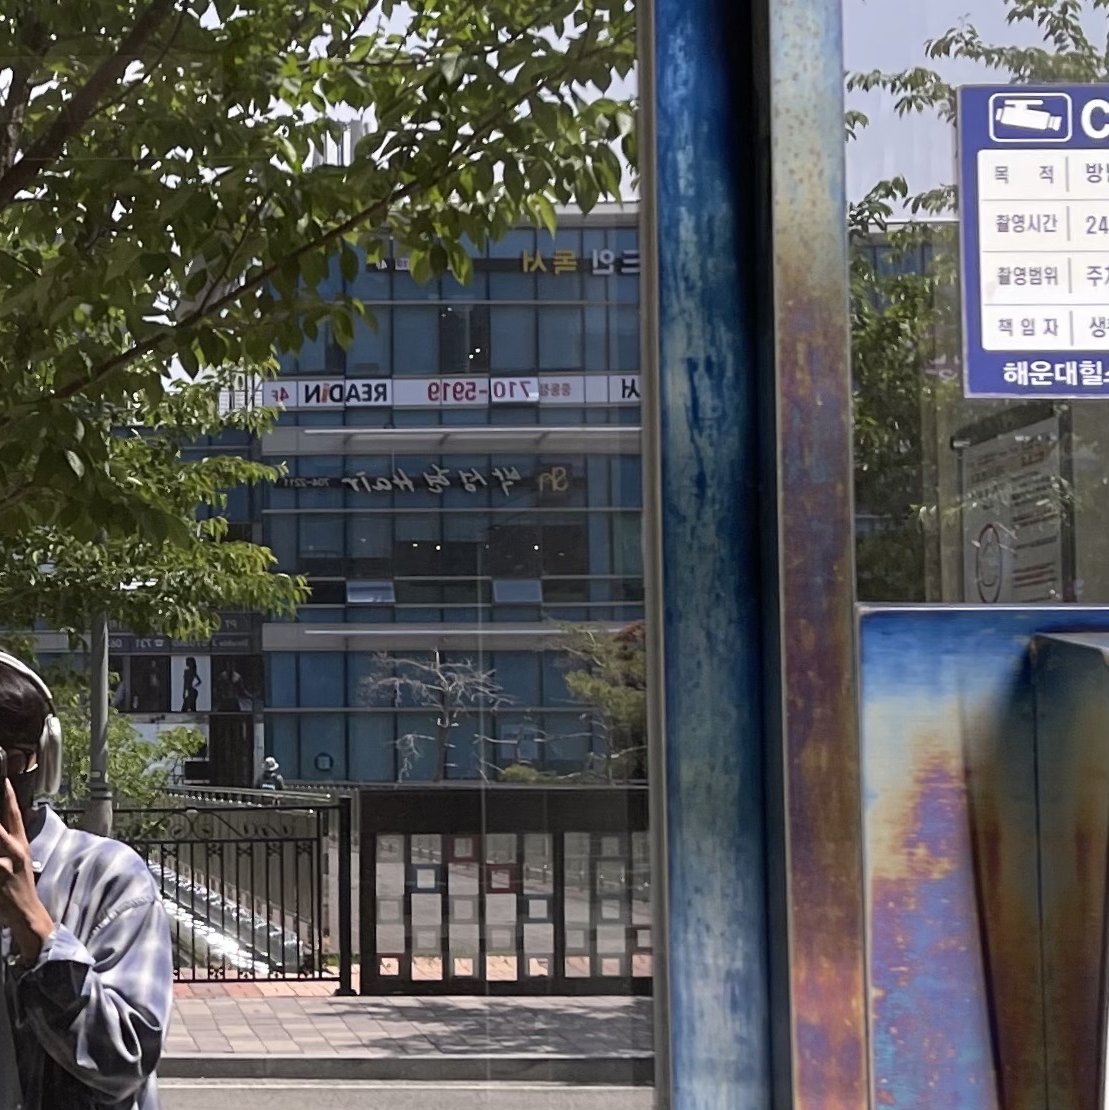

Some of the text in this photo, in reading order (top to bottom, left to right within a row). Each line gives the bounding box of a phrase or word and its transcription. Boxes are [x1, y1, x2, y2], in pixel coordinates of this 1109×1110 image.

[1086, 162, 1109, 184] 방
[996, 213, 1057, 233] 촬영시간
[997, 266, 1058, 286] 촬영범위
[1089, 316, 1109, 338] 생
